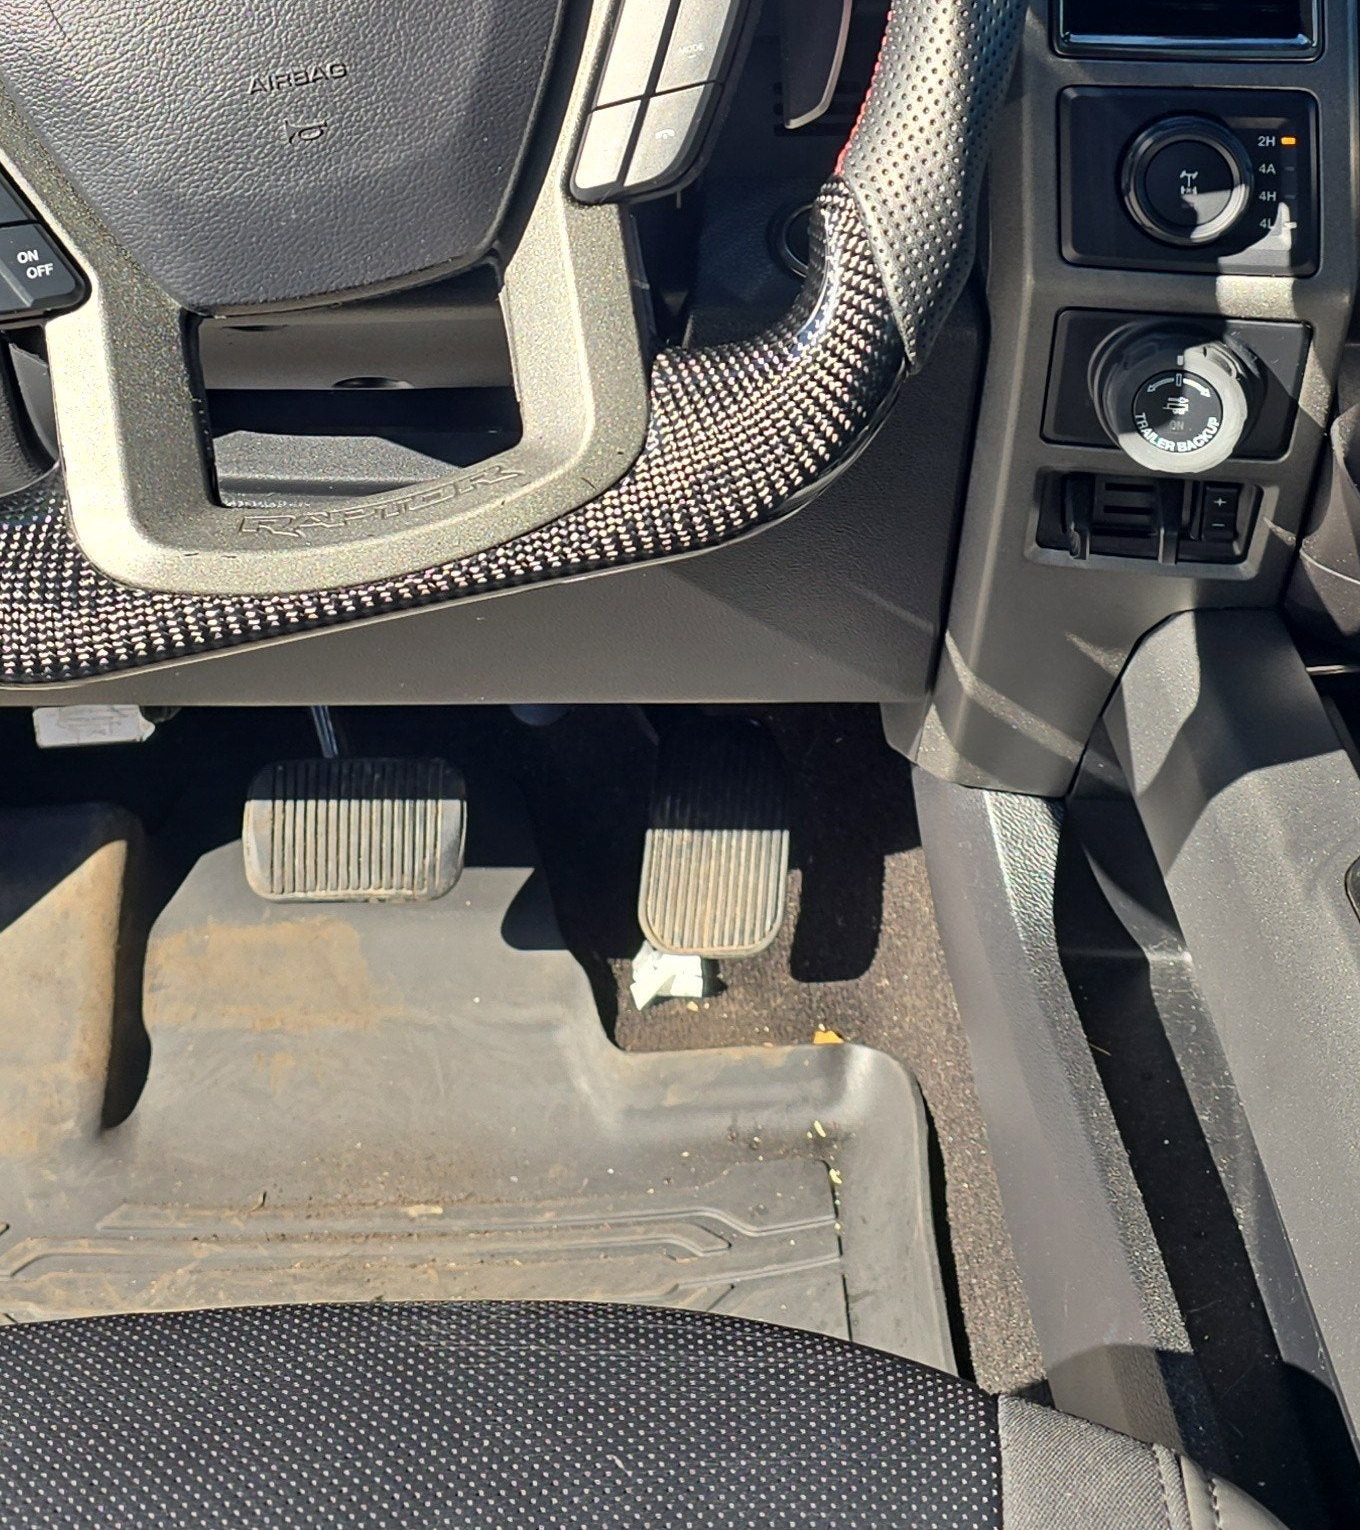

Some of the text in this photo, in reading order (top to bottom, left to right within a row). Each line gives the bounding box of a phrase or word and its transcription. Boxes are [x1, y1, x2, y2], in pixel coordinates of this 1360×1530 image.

[677, 42, 705, 52] MODE
[246, 62, 348, 95] AIRBAG
[1258, 136, 1276, 147] 2H
[1258, 163, 1276, 175] 4A
[1259, 191, 1277, 202] 4H
[1260, 217, 1274, 229] 4L
[16, 250, 39, 264] ON
[26, 263, 54, 280] OFF
[1135, 412, 1220, 452] TRAILER BACKUP
[239, 464, 525, 539] RAPTOR
